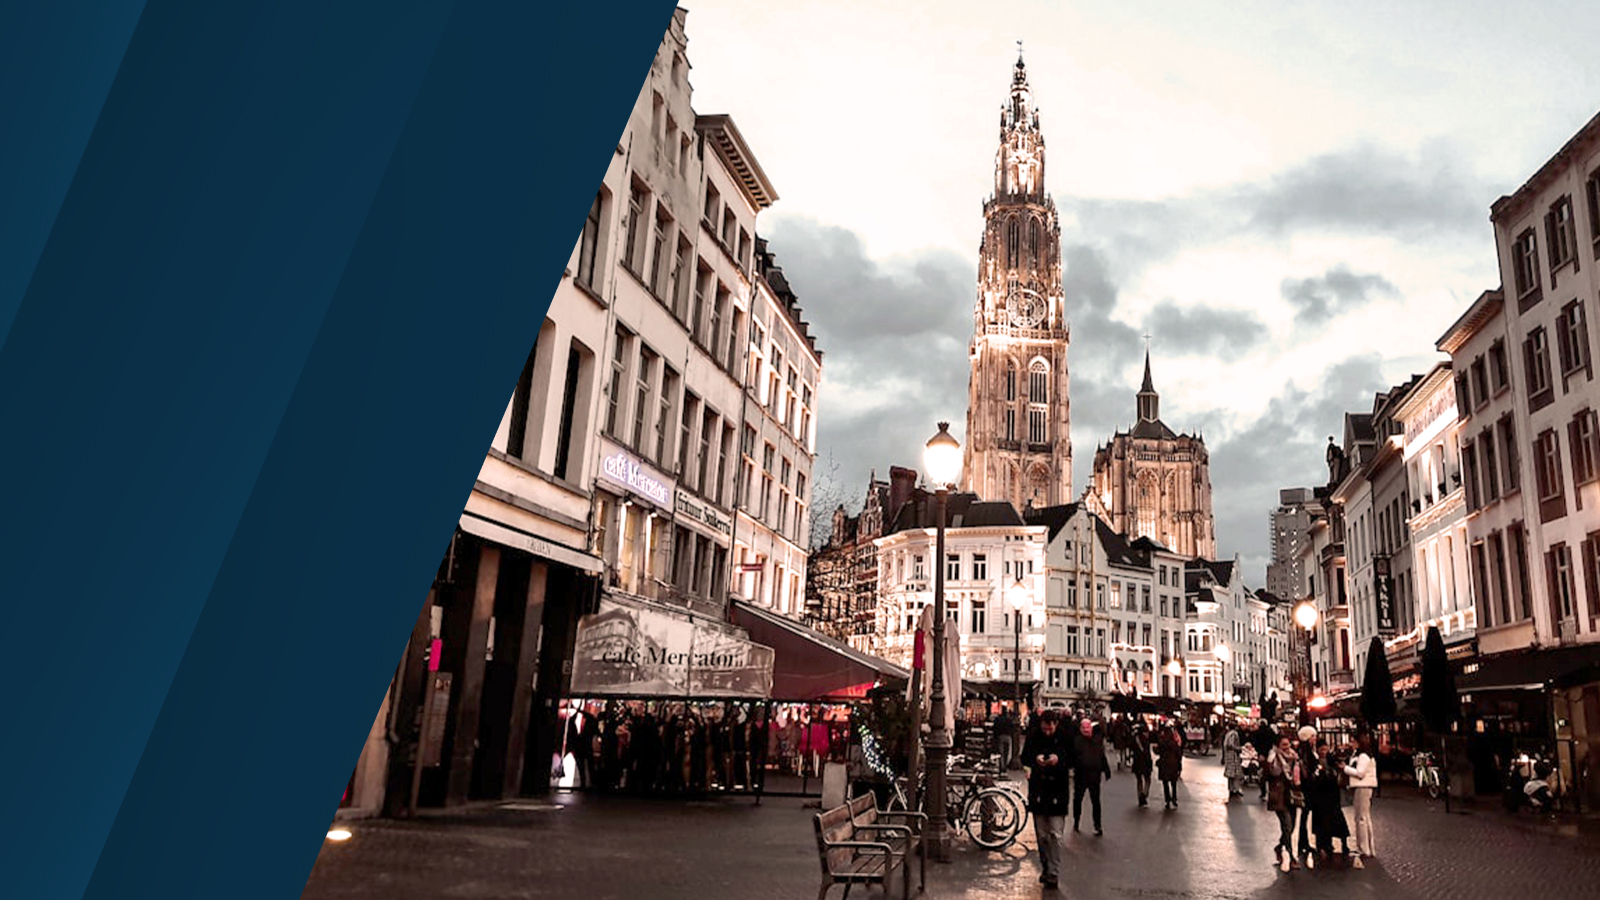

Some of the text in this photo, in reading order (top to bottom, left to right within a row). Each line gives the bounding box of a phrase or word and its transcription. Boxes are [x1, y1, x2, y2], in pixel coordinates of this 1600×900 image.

[603, 453, 669, 504] café Mercator
[602, 645, 739, 668] café Mercator
